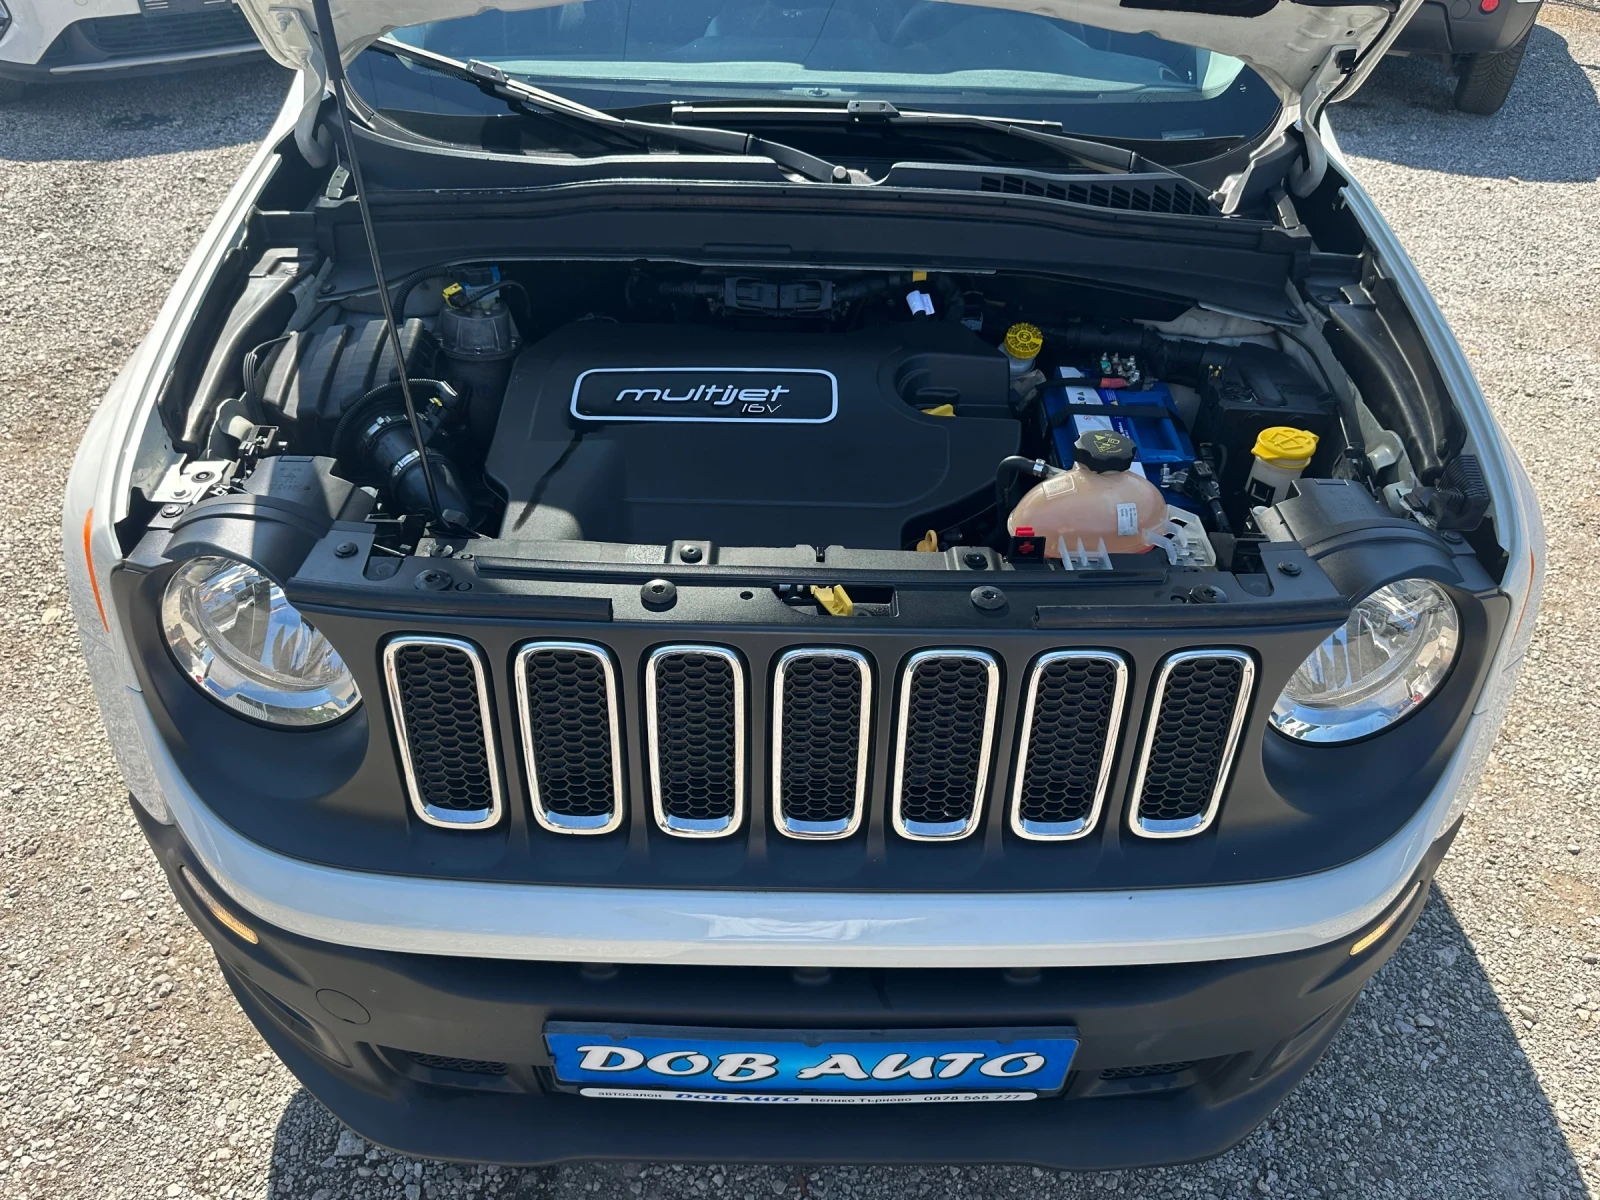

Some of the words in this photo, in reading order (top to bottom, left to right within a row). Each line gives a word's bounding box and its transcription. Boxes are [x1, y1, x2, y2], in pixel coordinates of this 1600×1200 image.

[615, 384, 790, 406] multijet
[741, 403, 782, 414] 16V
[576, 1045, 779, 1082] DOB
[797, 1051, 1047, 1081] AUTO
[675, 1093, 728, 1101] DOB
